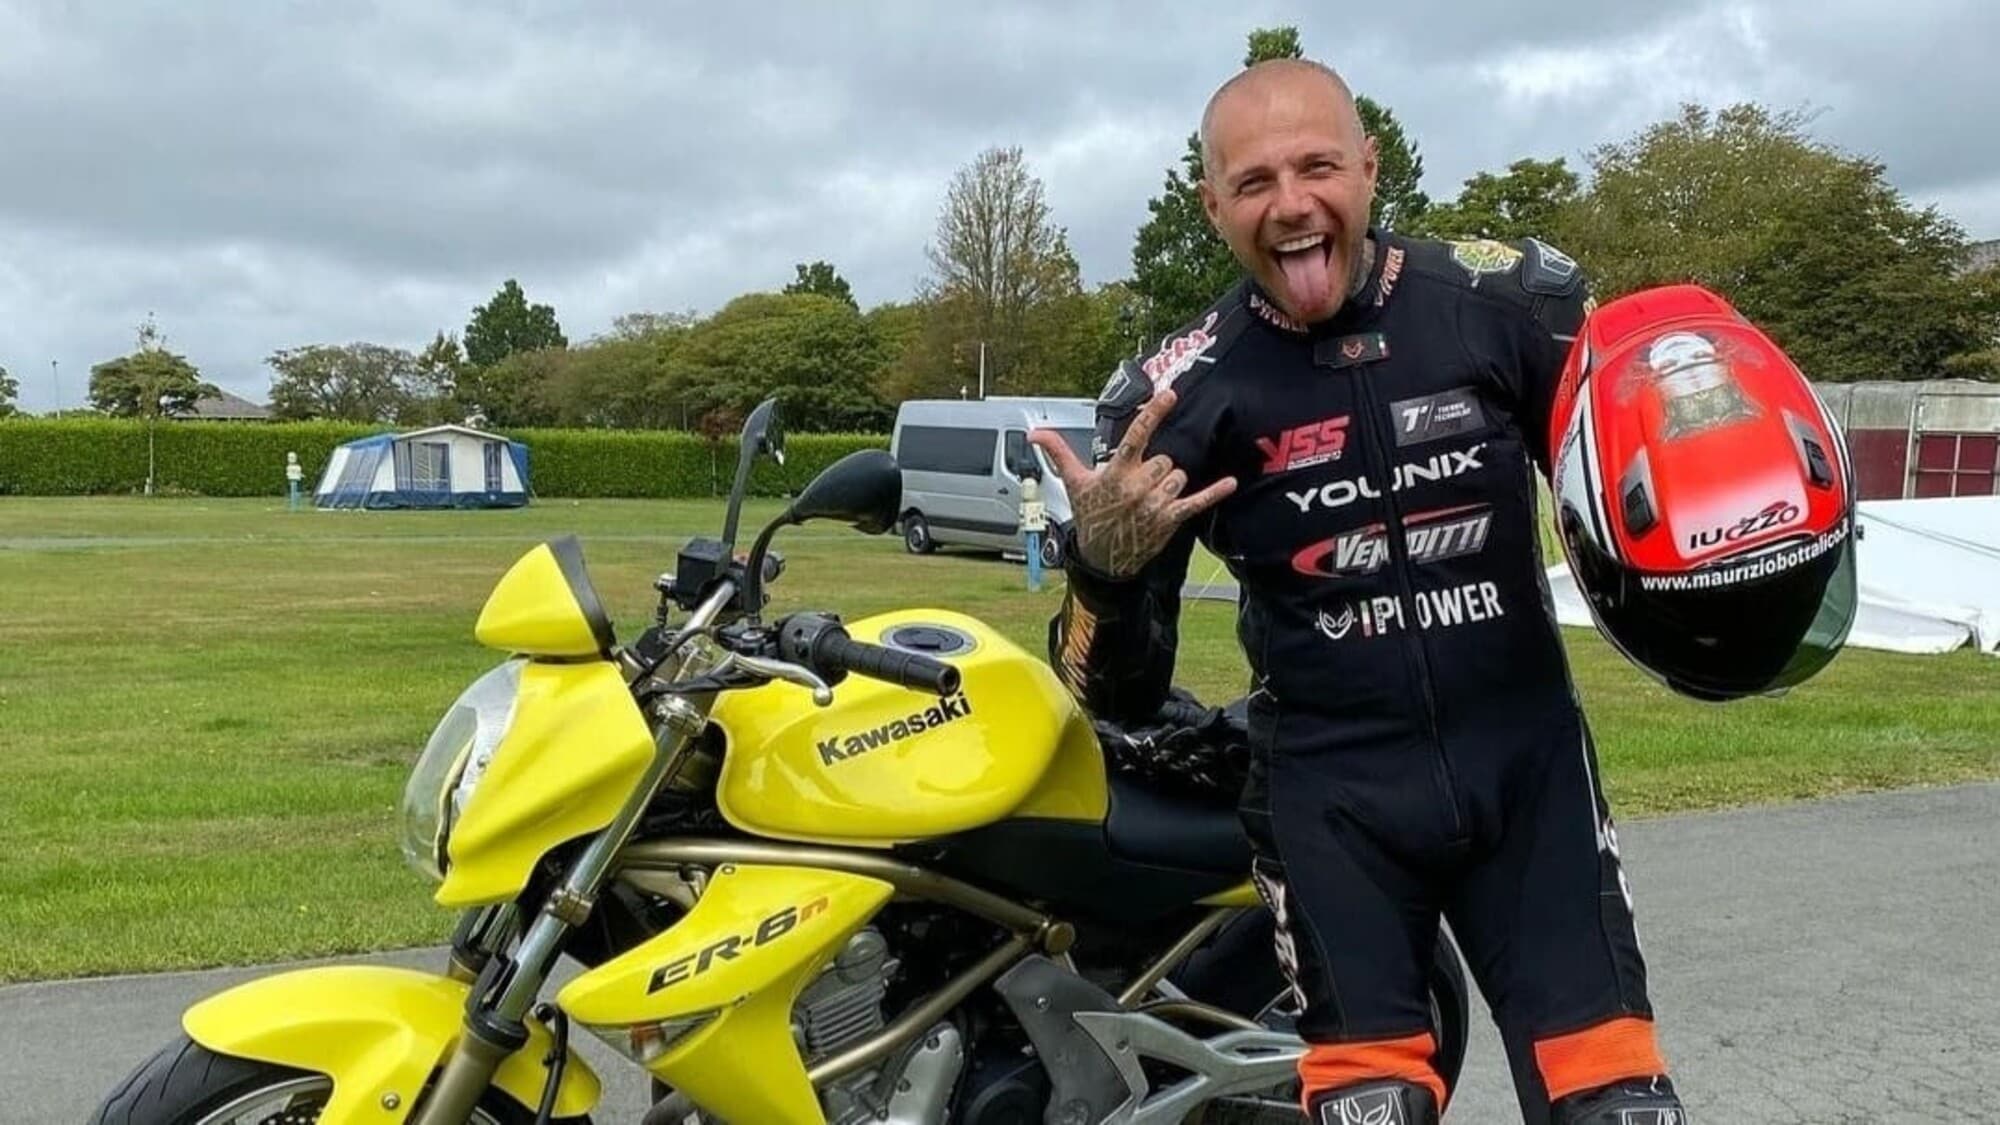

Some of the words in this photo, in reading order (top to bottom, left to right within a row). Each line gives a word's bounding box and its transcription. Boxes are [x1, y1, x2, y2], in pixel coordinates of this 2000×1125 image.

[1256, 415, 1350, 475] YSS
[1286, 444, 1483, 513] YOUNIX
[816, 691, 972, 766] Kawasaki
[646, 896, 829, 995] ER-6n
